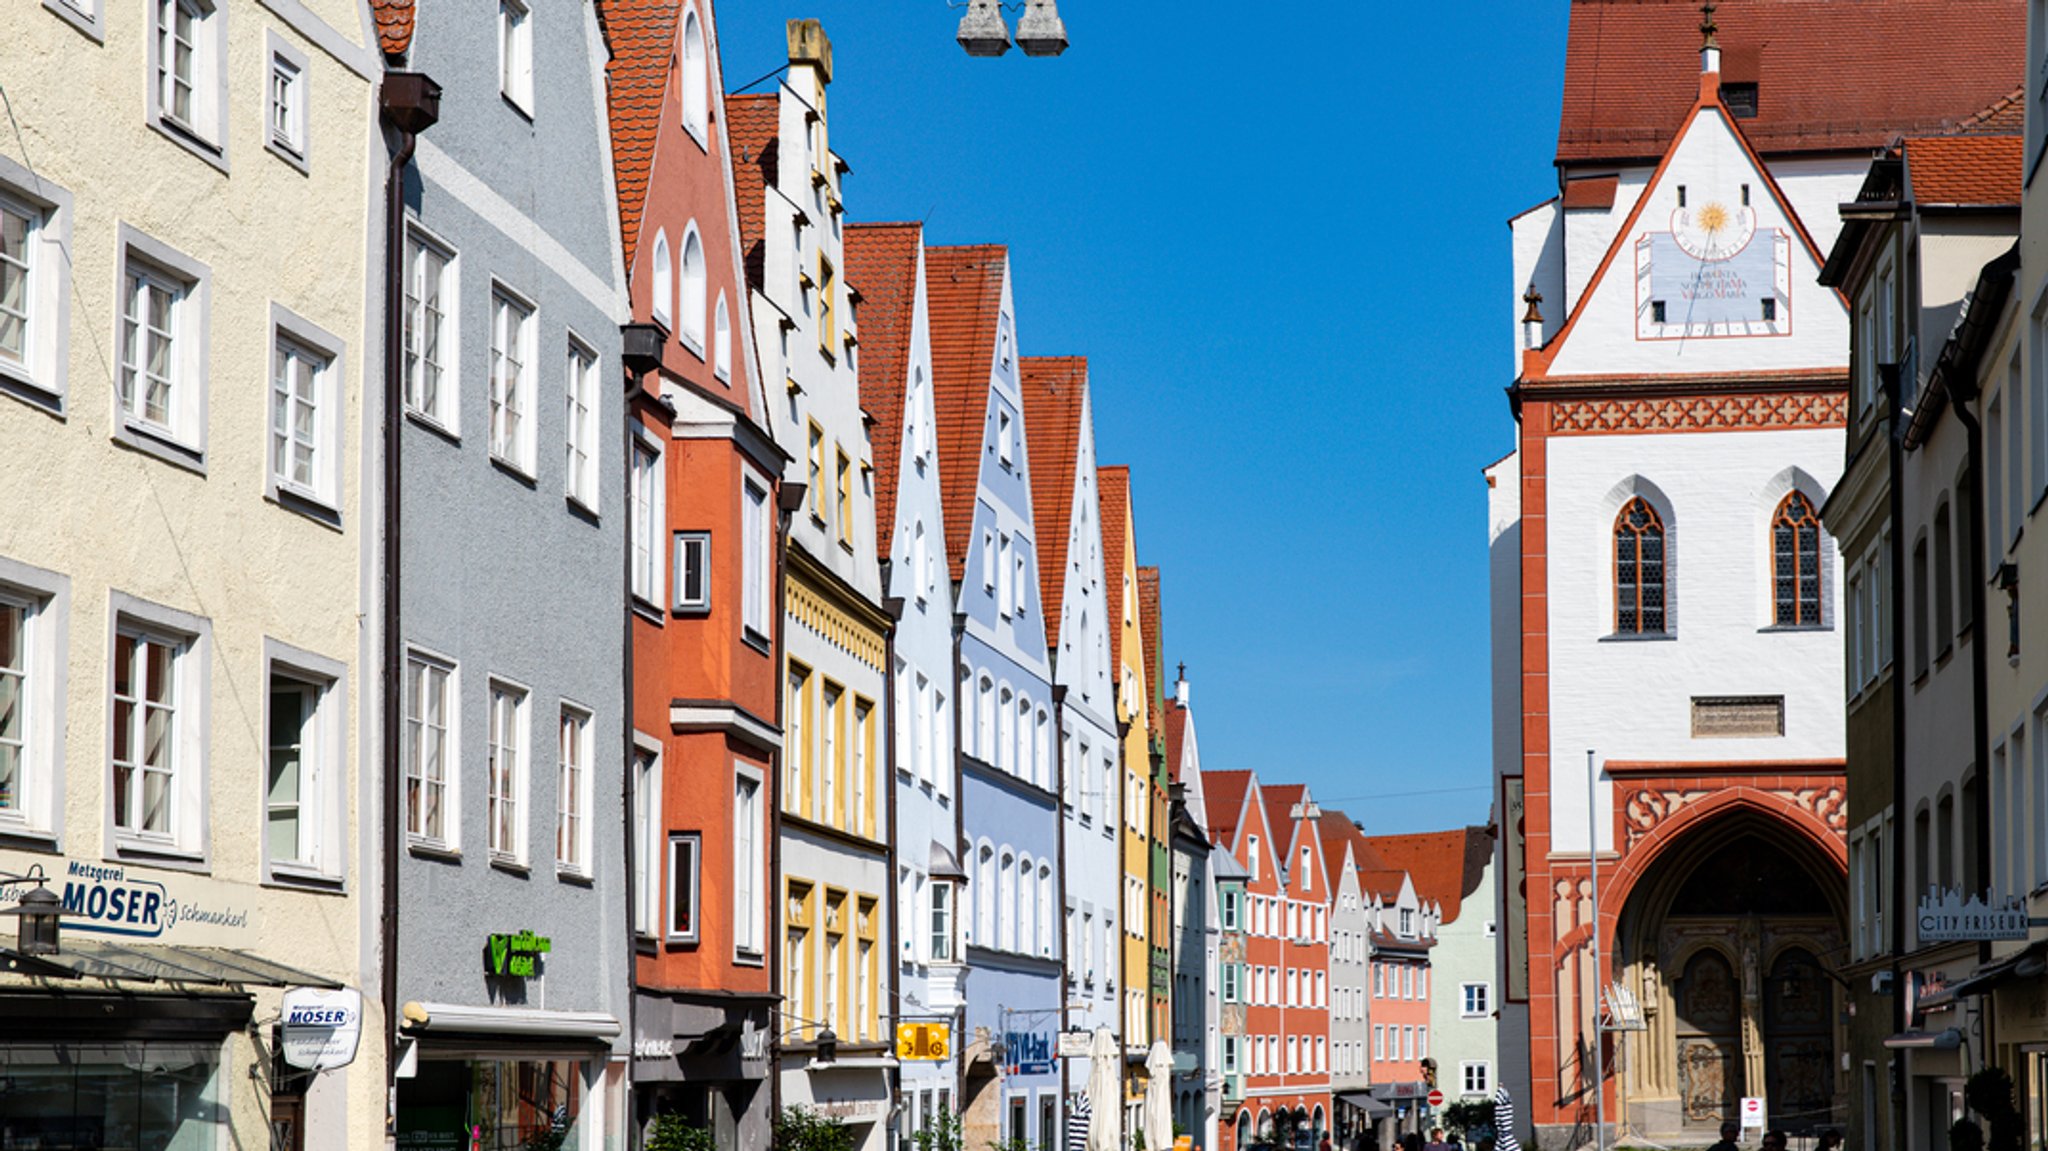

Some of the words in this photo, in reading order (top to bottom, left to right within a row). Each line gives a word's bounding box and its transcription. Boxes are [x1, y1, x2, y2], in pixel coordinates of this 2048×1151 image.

[67, 861, 124, 883] Metzgerei
[62, 881, 160, 925] MOSER
[1965, 914, 2026, 930] FRISEUR
[288, 1010, 345, 1024] MOSER
